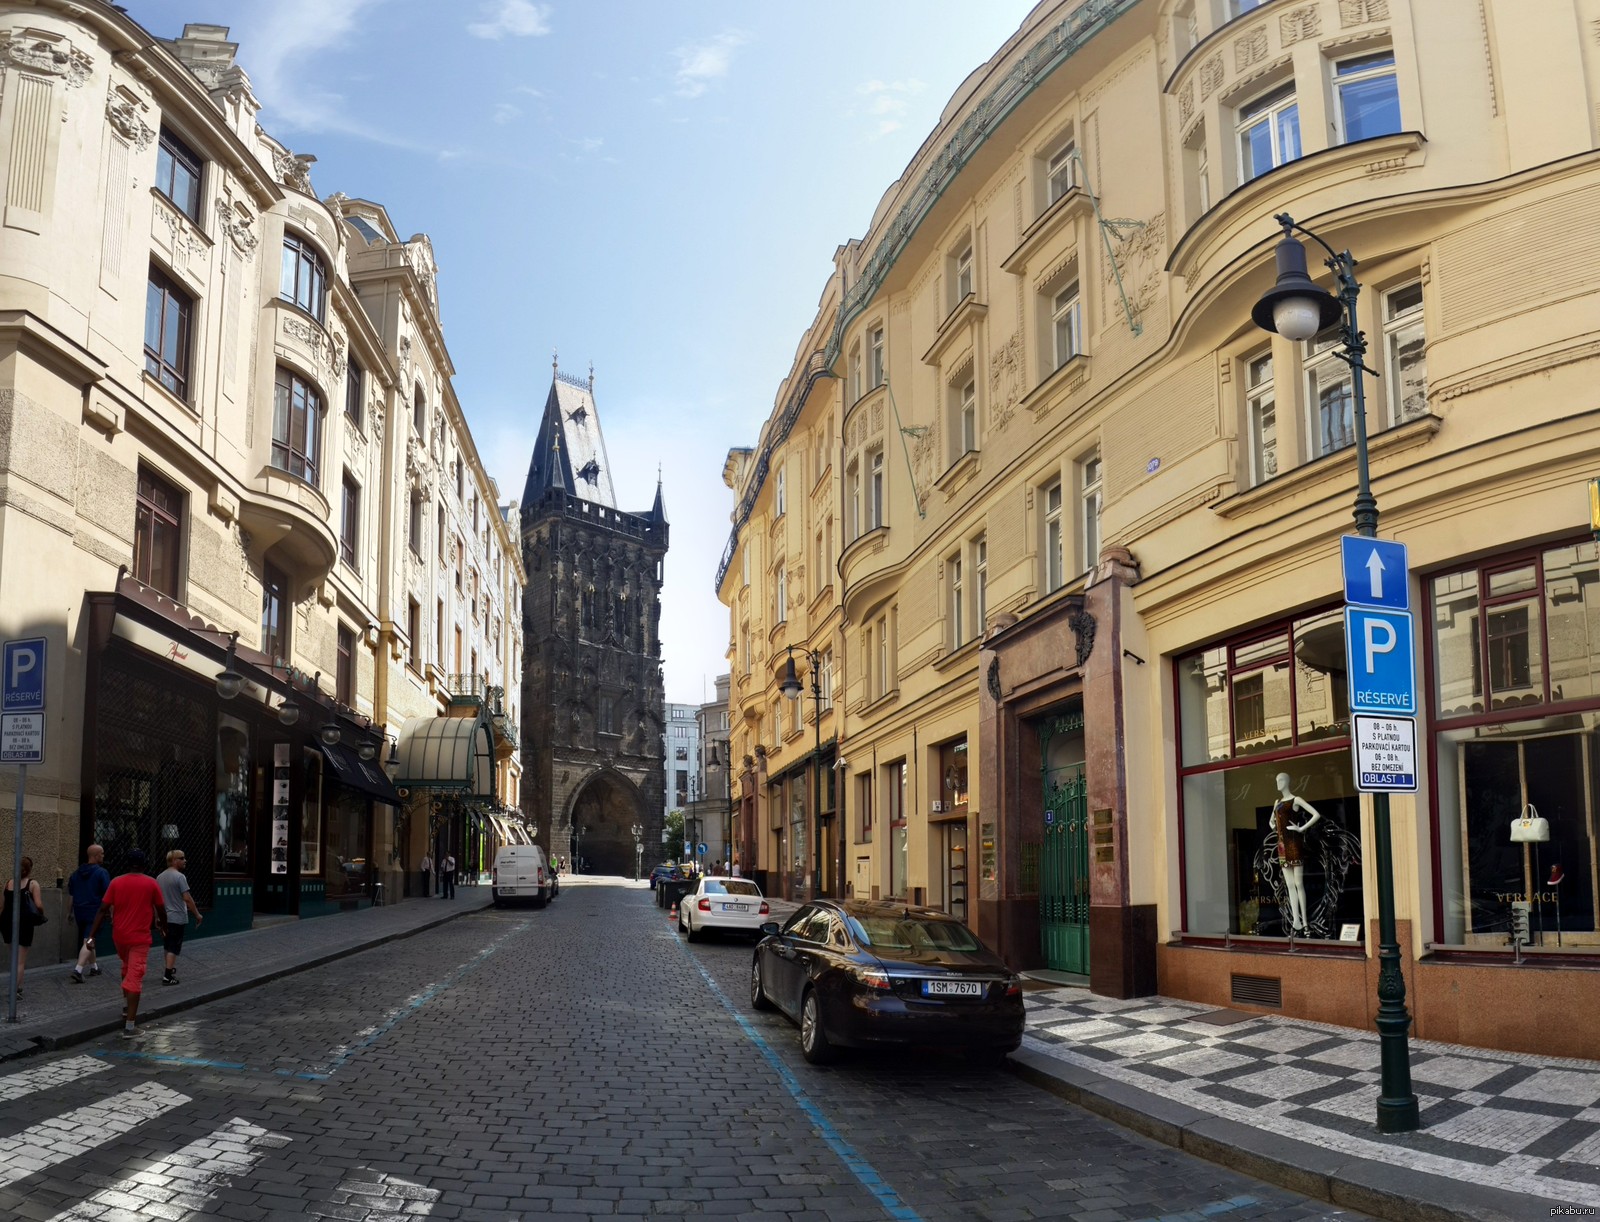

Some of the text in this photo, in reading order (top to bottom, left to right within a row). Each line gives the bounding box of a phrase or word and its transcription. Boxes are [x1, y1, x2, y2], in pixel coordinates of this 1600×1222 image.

[1364, 617, 1397, 674] P
[12, 648, 36, 688] P
[5, 691, 41, 702] RÉSERVÉ
[1357, 689, 1410, 706] RÉSERVÉ
[1373, 722, 1380, 730] 08
[1386, 723, 1392, 731] 06
[1372, 732, 1400, 742] S PLATNOU
[1362, 742, 1411, 752] PARKOVACÍ KARTOU
[1375, 753, 1382, 761] 06
[1387, 753, 1393, 761] 08
[1371, 762, 1404, 772] BEZ OMEZENÍ
[1364, 773, 1406, 783] OBLAST 1
[930, 982, 977, 994] 1SM 7670
